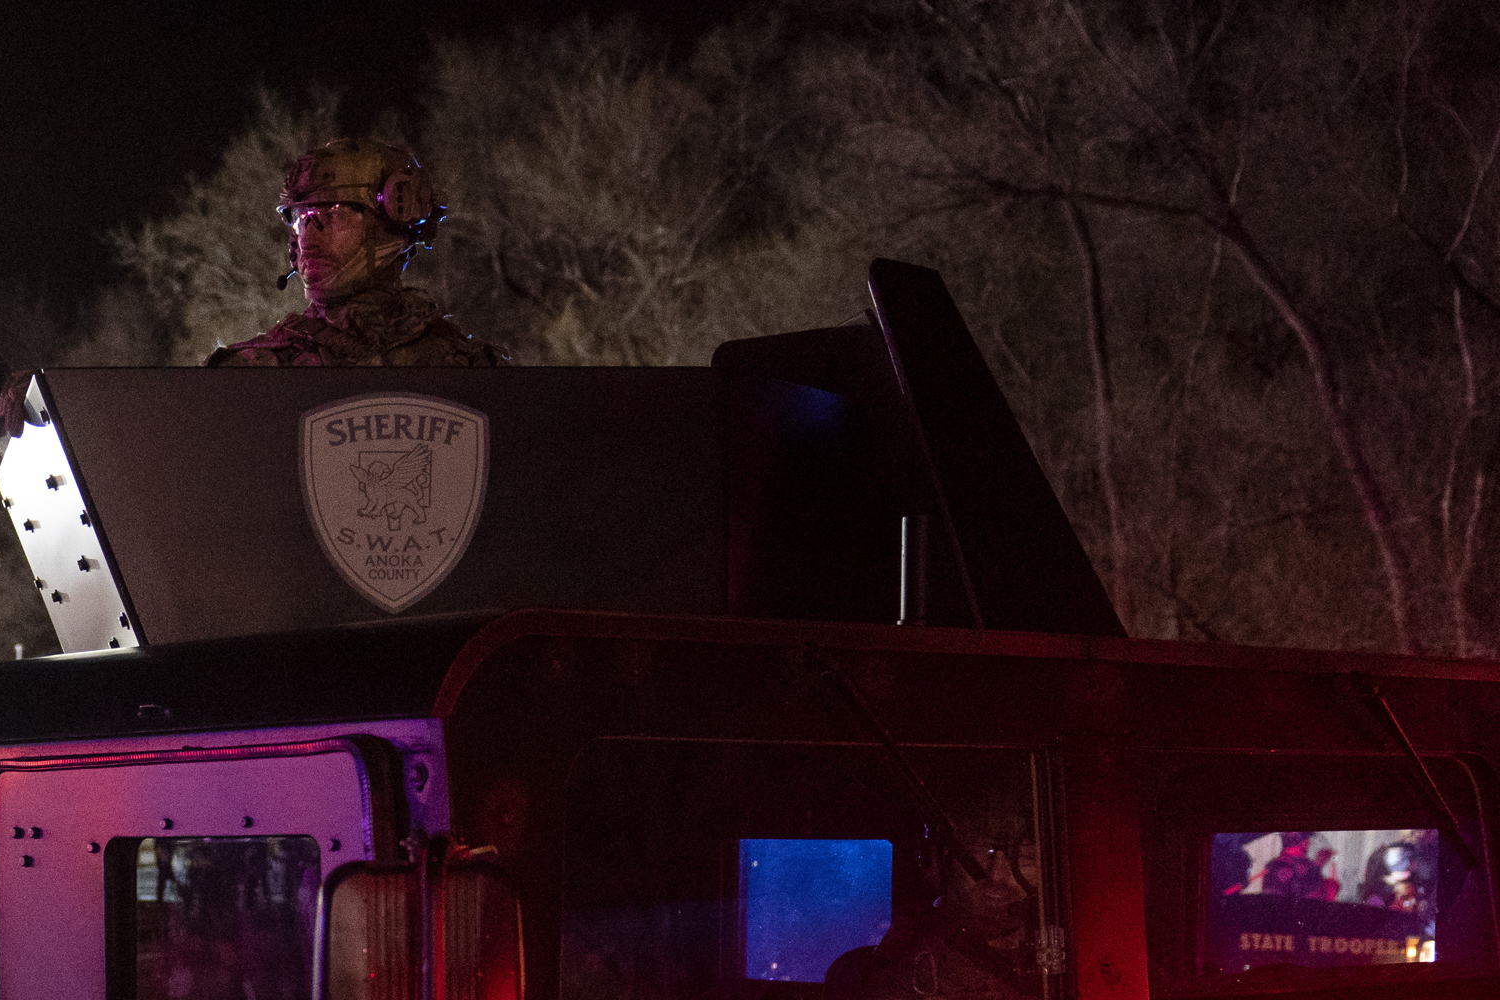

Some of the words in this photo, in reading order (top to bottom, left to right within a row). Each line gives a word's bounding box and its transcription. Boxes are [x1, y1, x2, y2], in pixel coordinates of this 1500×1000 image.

[325, 414, 464, 446] SHERIFF
[336, 527, 456, 553] S.W.A.T.
[365, 555, 424, 567] ANOKA
[368, 568, 421, 580] COUNTY
[1240, 932, 1295, 951] STATE
